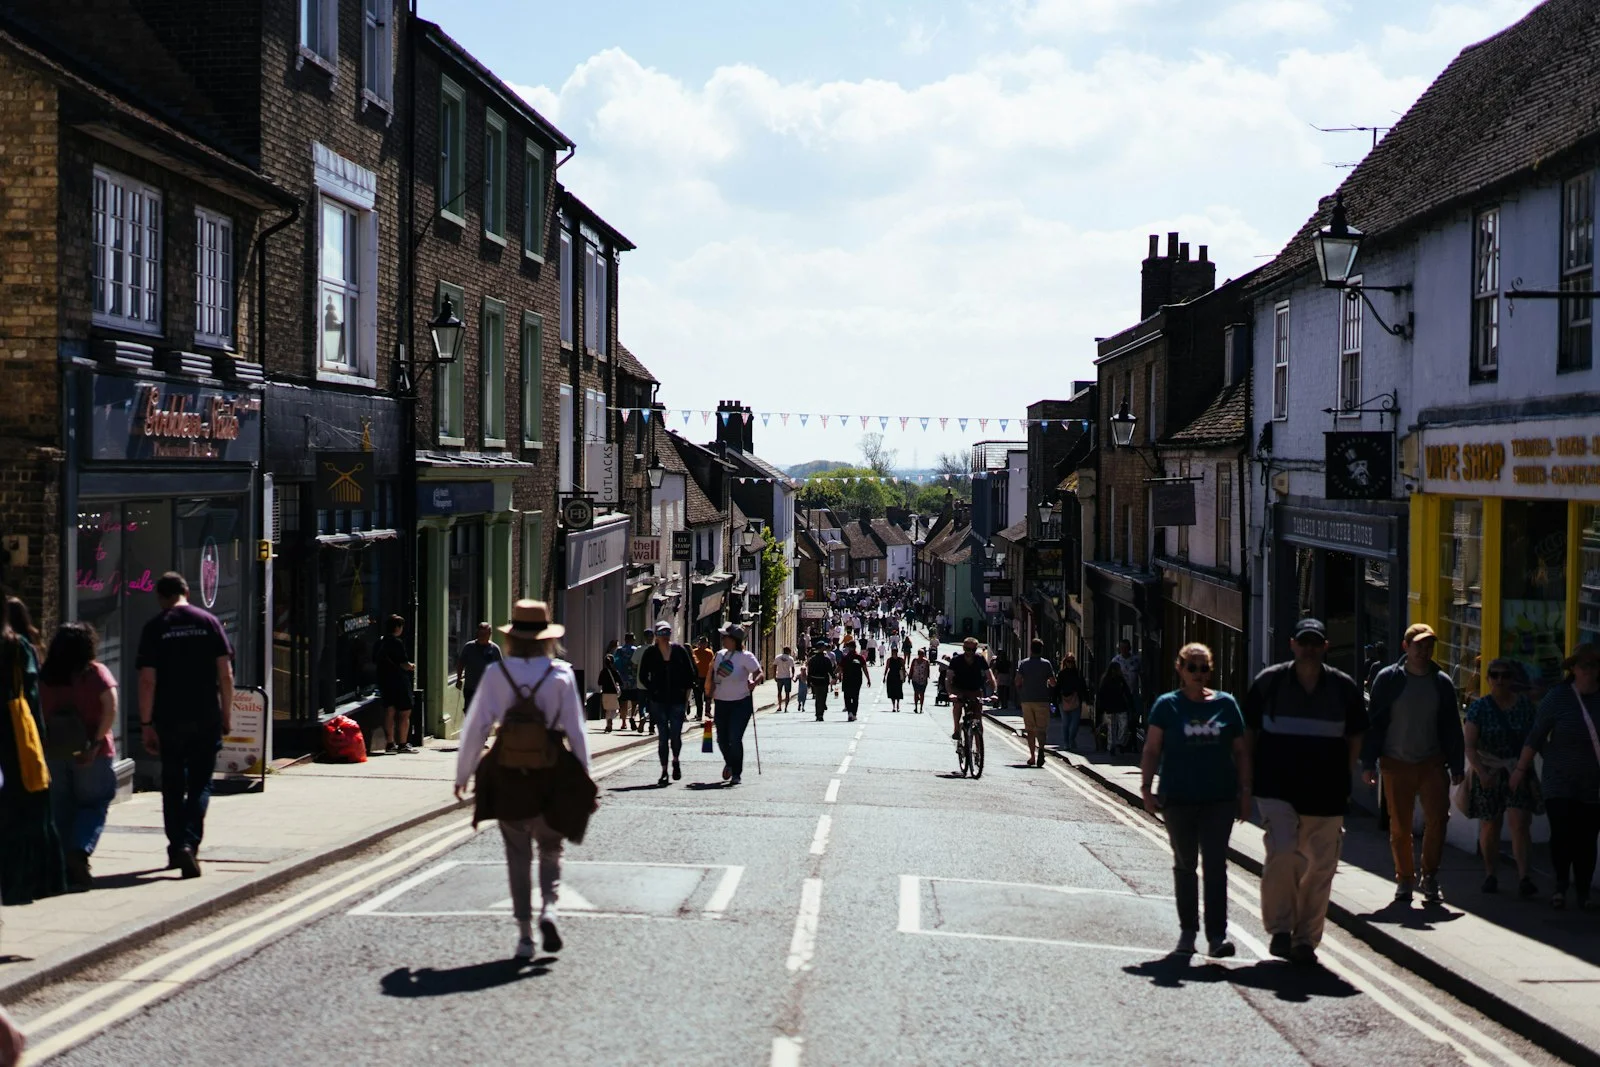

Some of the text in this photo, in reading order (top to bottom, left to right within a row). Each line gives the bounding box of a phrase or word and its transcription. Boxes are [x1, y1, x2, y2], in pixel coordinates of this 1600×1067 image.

[1425, 444, 1459, 481] VAPE
[1462, 443, 1505, 481] SHOP
[603, 446, 613, 502] CUTLACKS
[633, 540, 650, 550] the
[1329, 522, 1351, 541] COFFEE
[1352, 524, 1373, 546] HOUSE
[633, 540, 661, 560] wall
[232, 702, 262, 712] Nails
